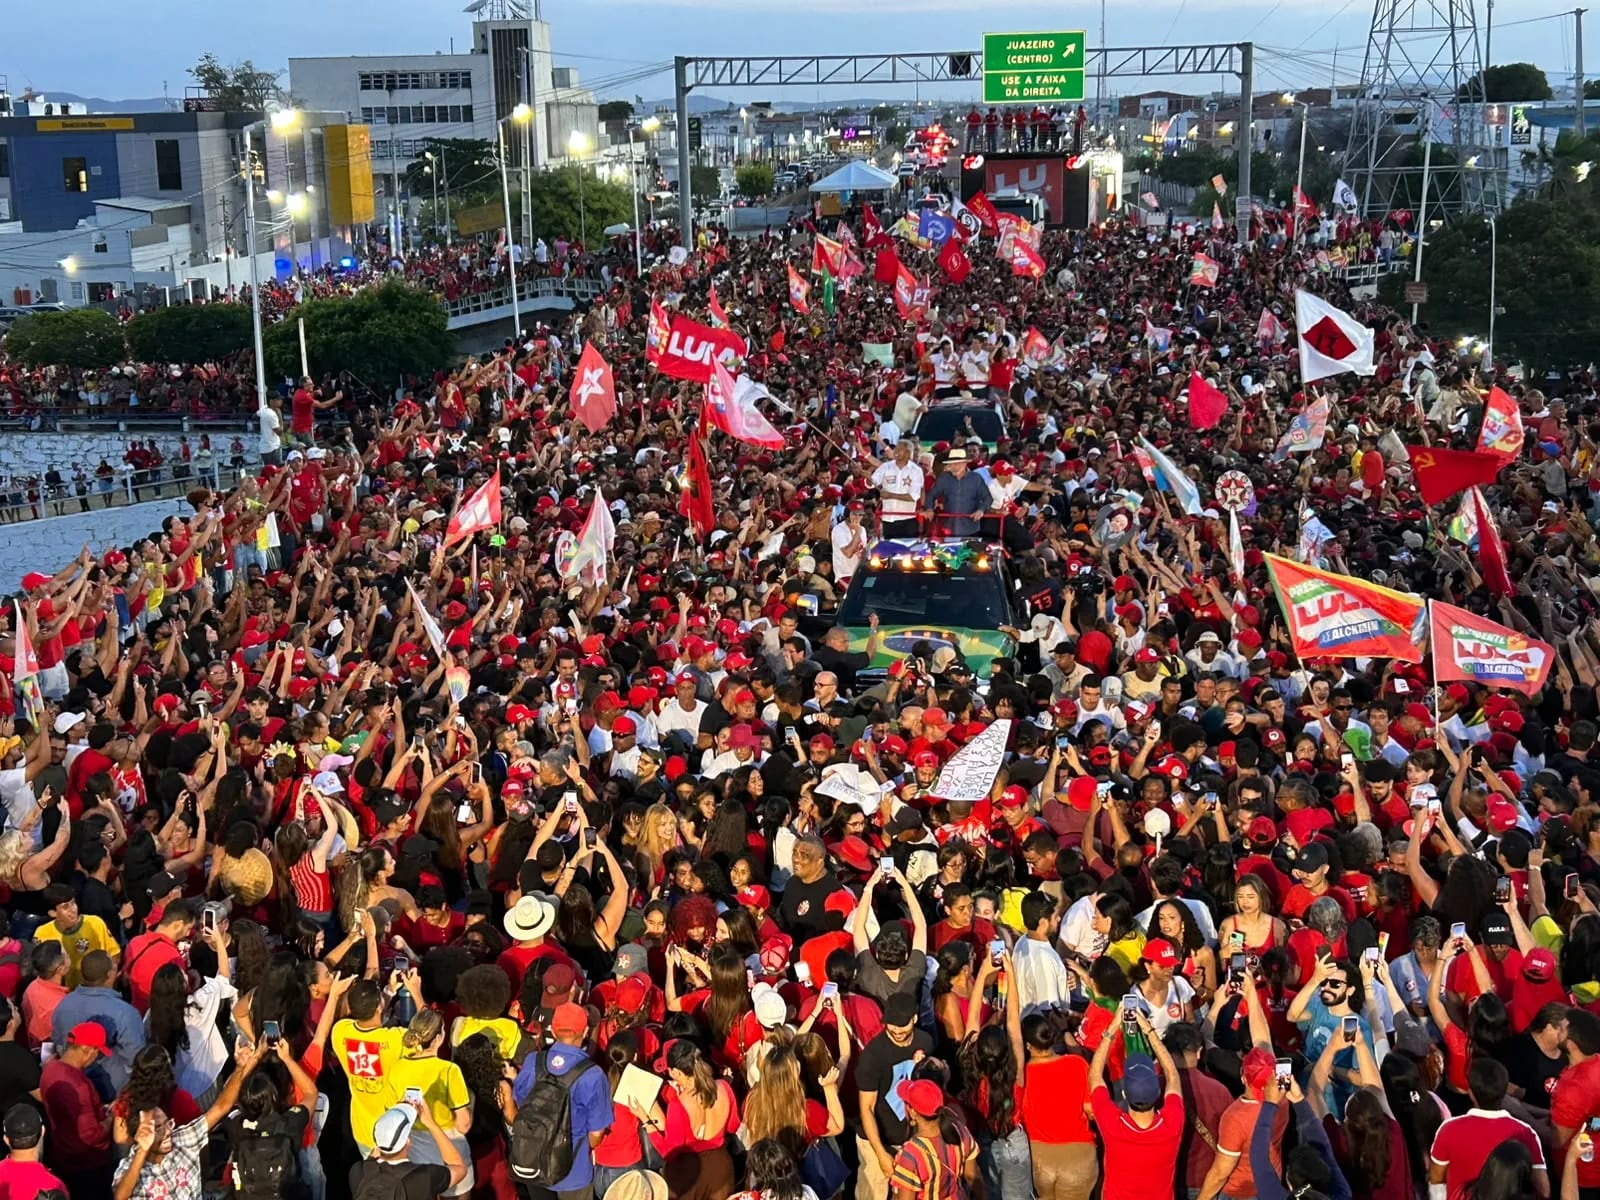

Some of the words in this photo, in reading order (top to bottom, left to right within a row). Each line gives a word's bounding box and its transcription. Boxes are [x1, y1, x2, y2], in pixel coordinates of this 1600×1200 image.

[1006, 40, 1055, 50] JUAZEIRO
[1007, 54, 1053, 64] (CENTRO)
[1001, 76, 1021, 85] USE
[1025, 76, 1032, 84] A
[1036, 74, 1066, 84] FAIXA
[1006, 88, 1018, 96] DA
[1023, 87, 1061, 96] DIREITA
[355, 1054, 369, 1069] 13
